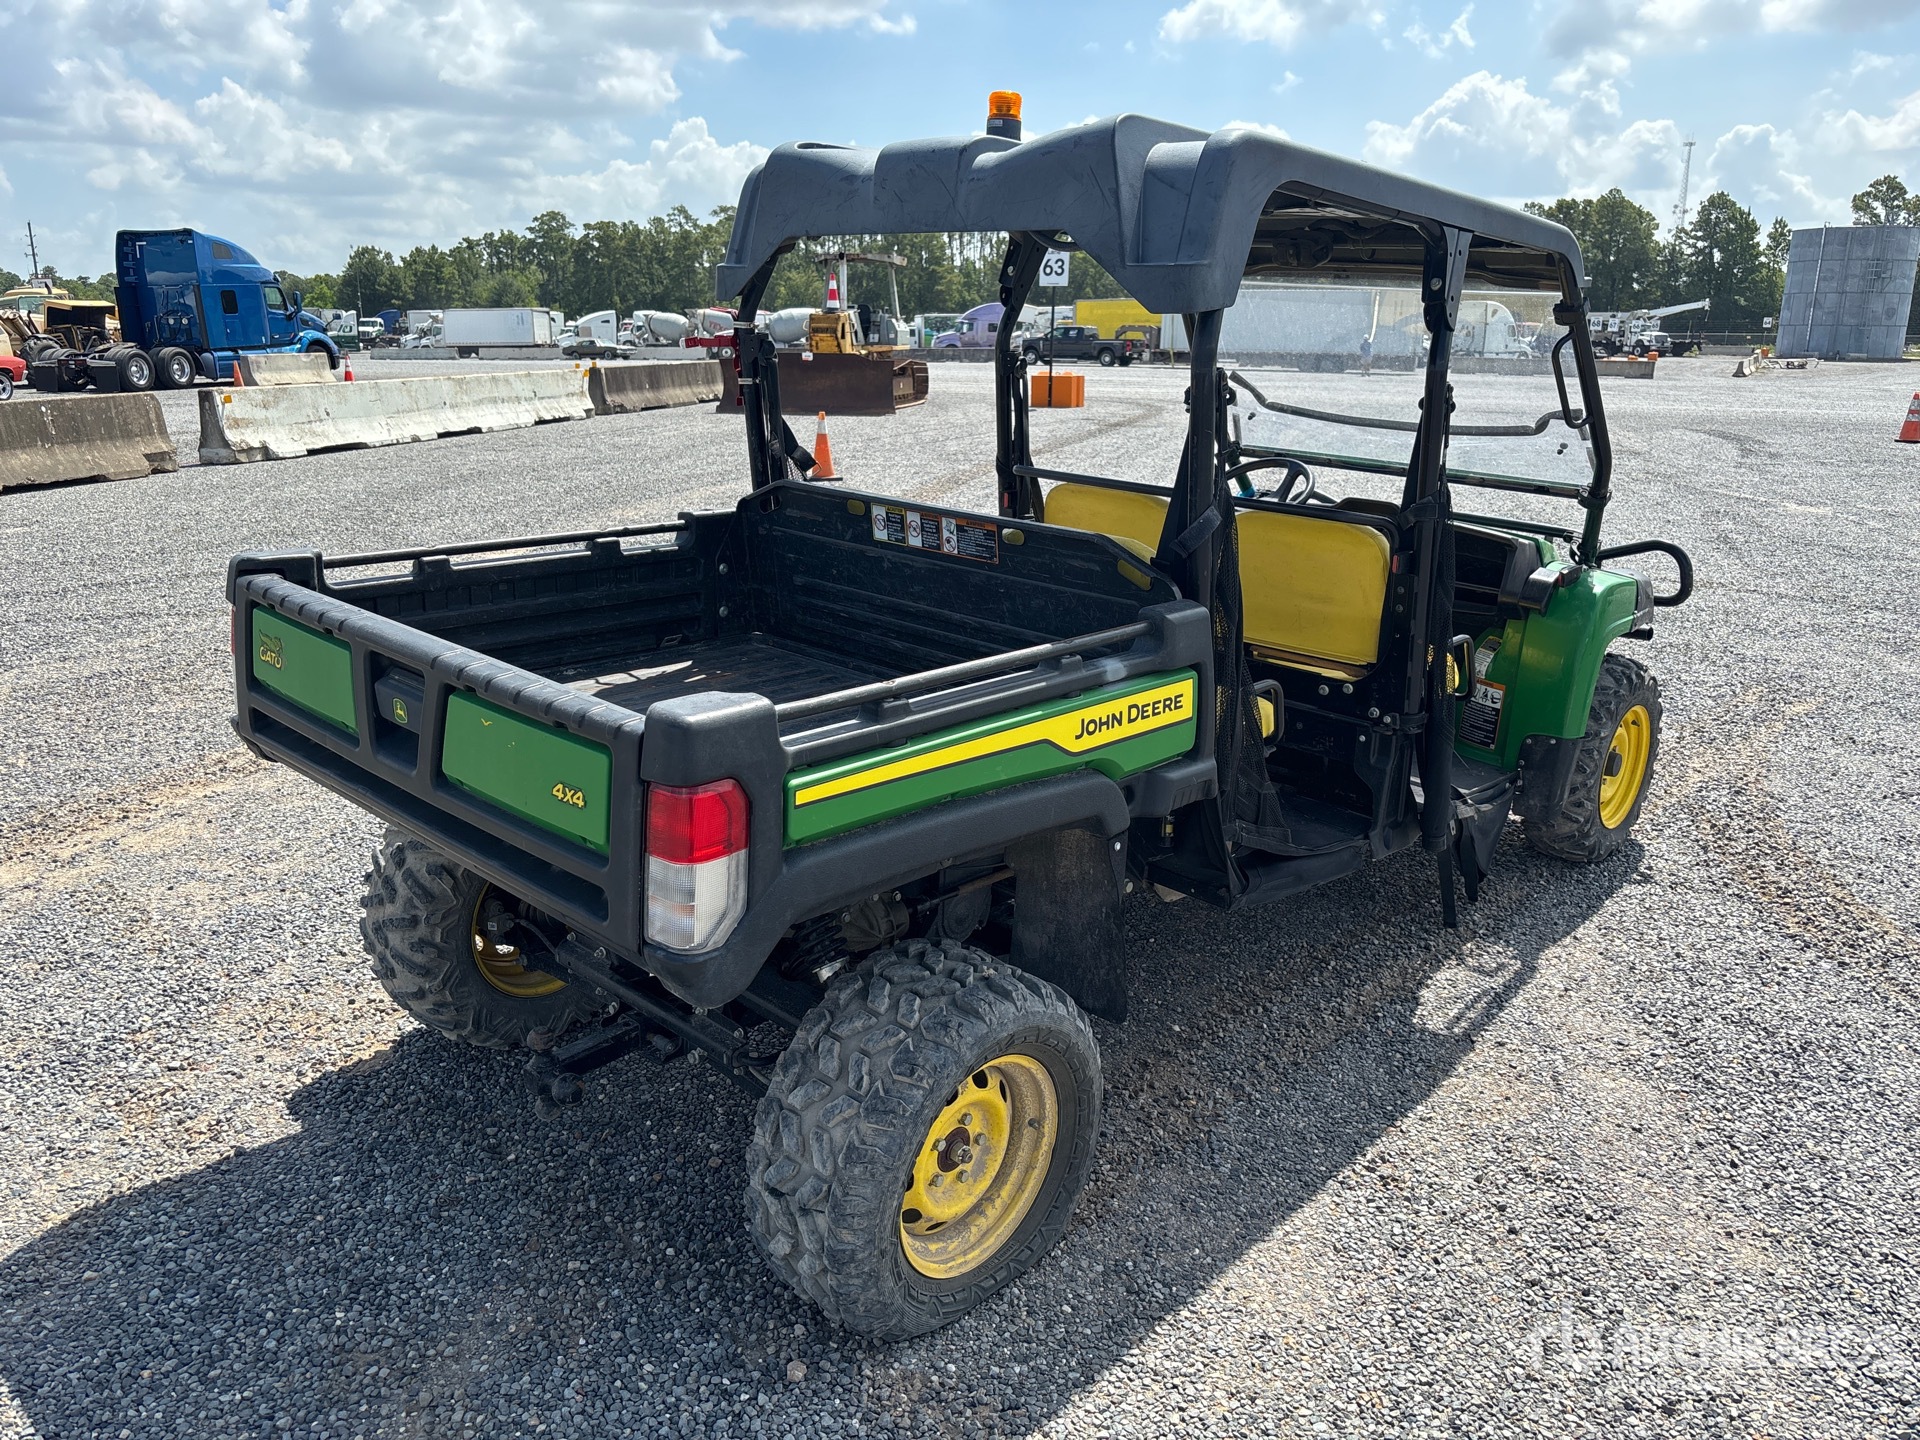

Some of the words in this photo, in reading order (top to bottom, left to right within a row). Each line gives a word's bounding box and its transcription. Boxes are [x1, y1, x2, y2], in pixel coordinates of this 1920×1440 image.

[1043, 258, 1065, 276] 63
[1074, 710, 1123, 740] JOHN
[1127, 693, 1184, 724] DEERE
